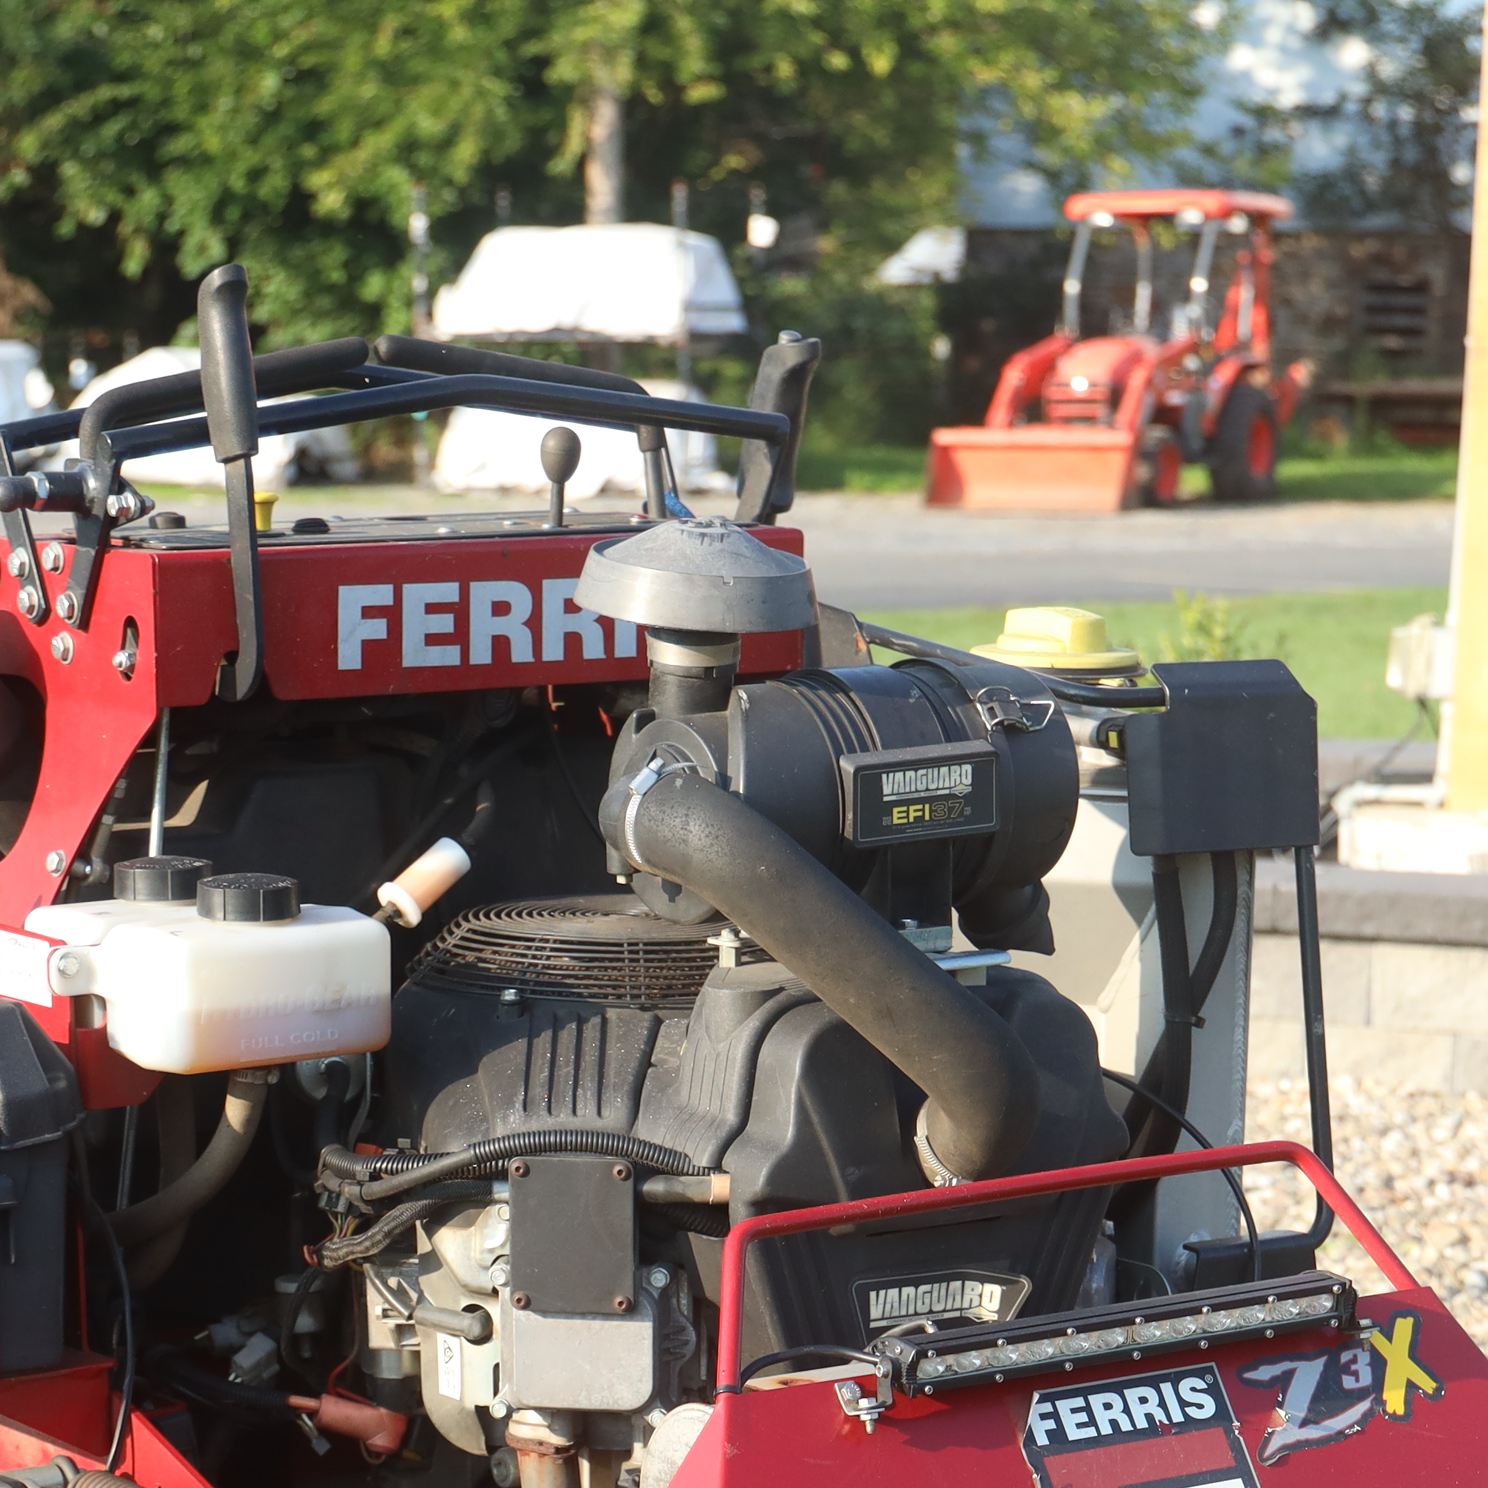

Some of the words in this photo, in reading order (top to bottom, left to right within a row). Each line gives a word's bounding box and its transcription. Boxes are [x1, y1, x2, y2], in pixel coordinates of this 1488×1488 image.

[337, 578, 638, 671] FERR
[881, 764, 973, 795] VANGUARD
[240, 1034, 286, 1051] FULL
[290, 1028, 340, 1045] COLD
[869, 1280, 1002, 1320] VANGUARD
[1030, 1379, 1216, 1446] FERRIS
